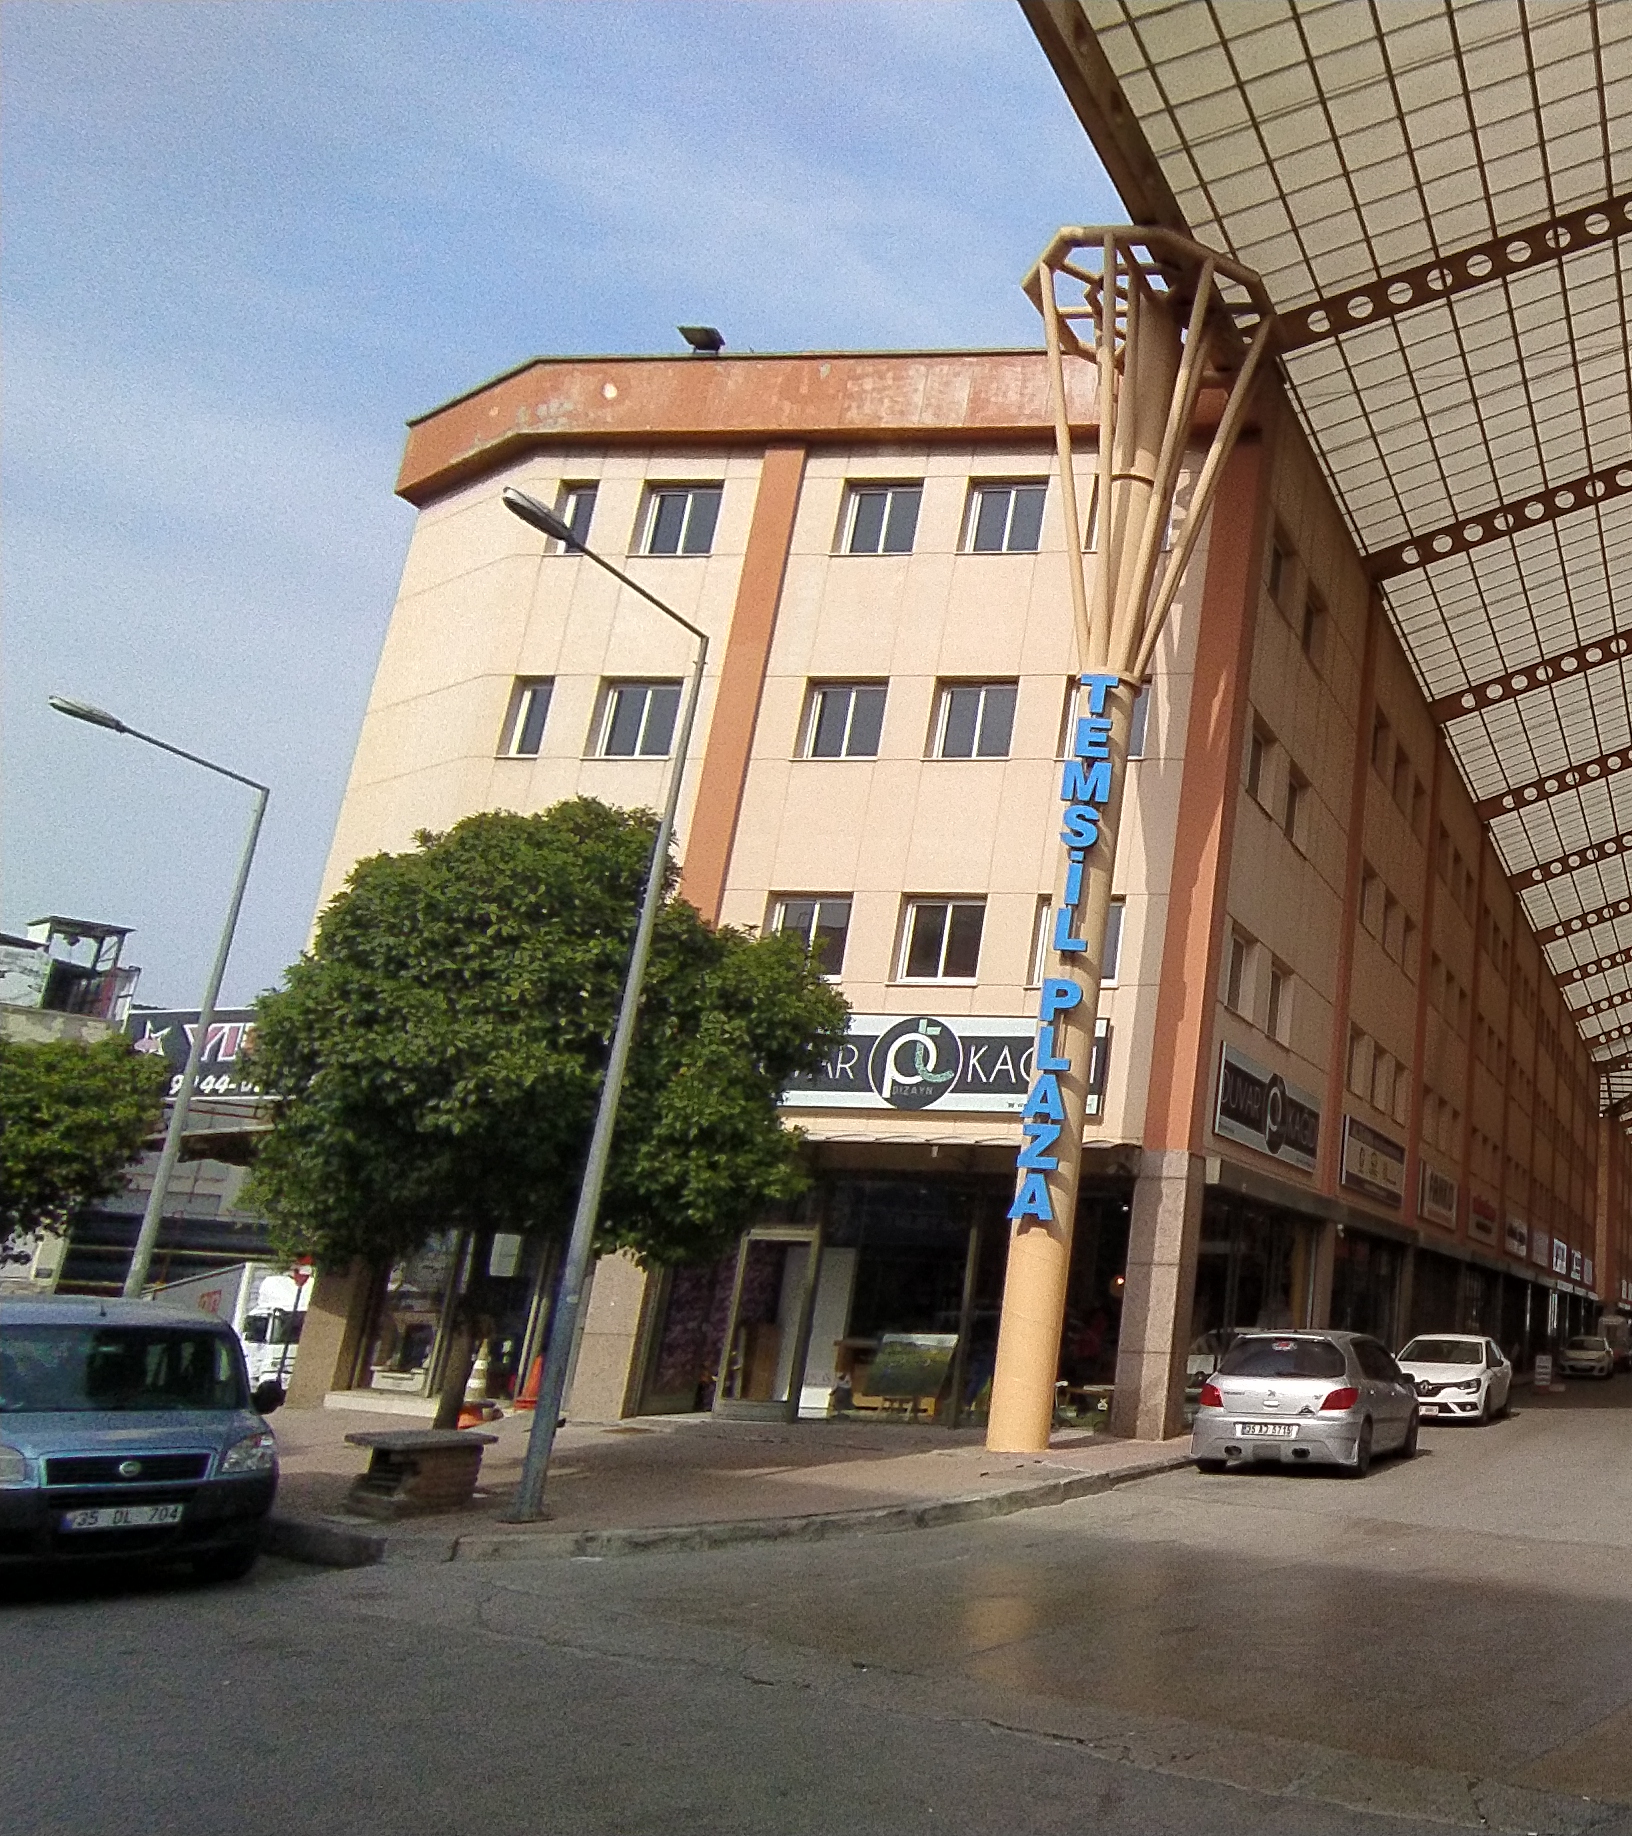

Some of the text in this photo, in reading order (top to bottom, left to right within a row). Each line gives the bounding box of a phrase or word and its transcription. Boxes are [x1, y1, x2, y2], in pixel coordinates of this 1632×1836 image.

[1007, 674, 1119, 1220] TEMSİL PLAZA
[112, 1510, 131, 1525] DL
[148, 1507, 178, 1521] 704
